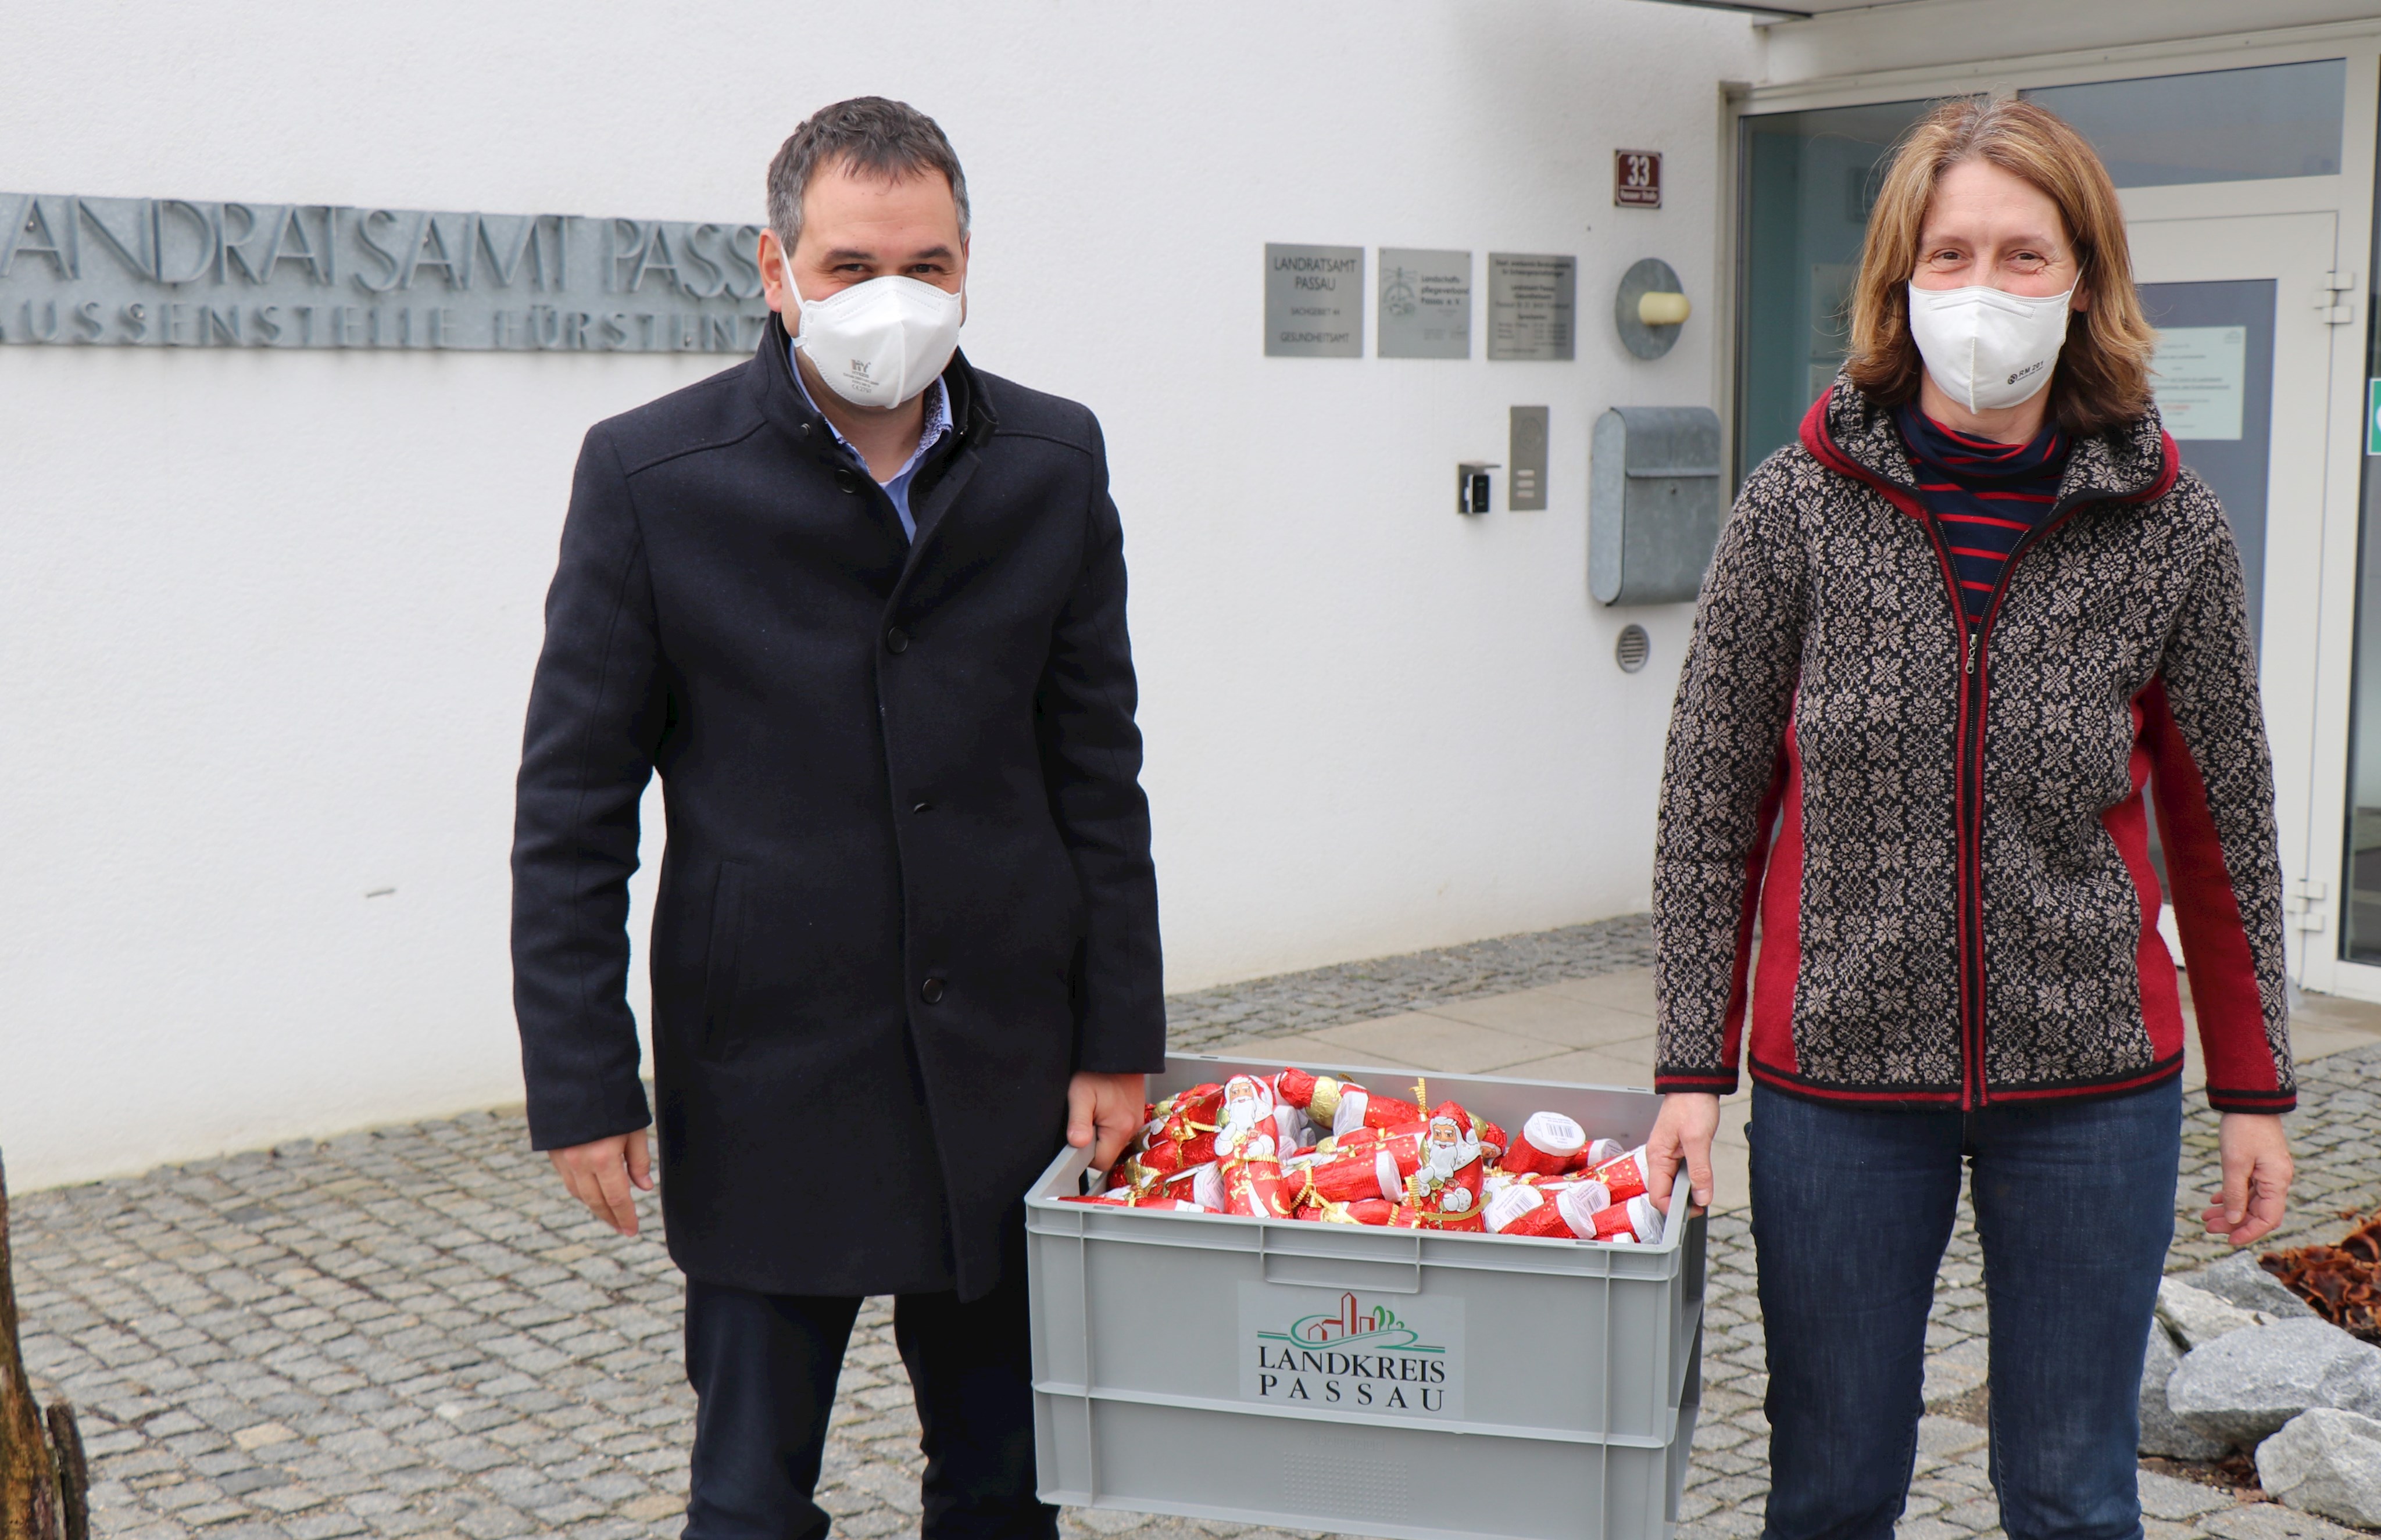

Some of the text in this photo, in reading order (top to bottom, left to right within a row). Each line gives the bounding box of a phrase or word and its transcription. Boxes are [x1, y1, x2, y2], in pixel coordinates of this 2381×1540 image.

[1628, 155, 1650, 186] 33
[0, 195, 764, 299] ANDRATSAMT PASS
[1274, 256, 1357, 273] LANDRATSAMT
[1295, 275, 1336, 291] PASSAU
[0, 299, 457, 348] USSENSTELLE
[1281, 331, 1349, 343] GESUNDHEITSAMT
[2019, 367, 2030, 377] RM
[2032, 360, 2043, 371] 201
[1259, 1346, 1446, 1384] LANDKREIS
[1259, 1374, 1445, 1412] PASSAU
